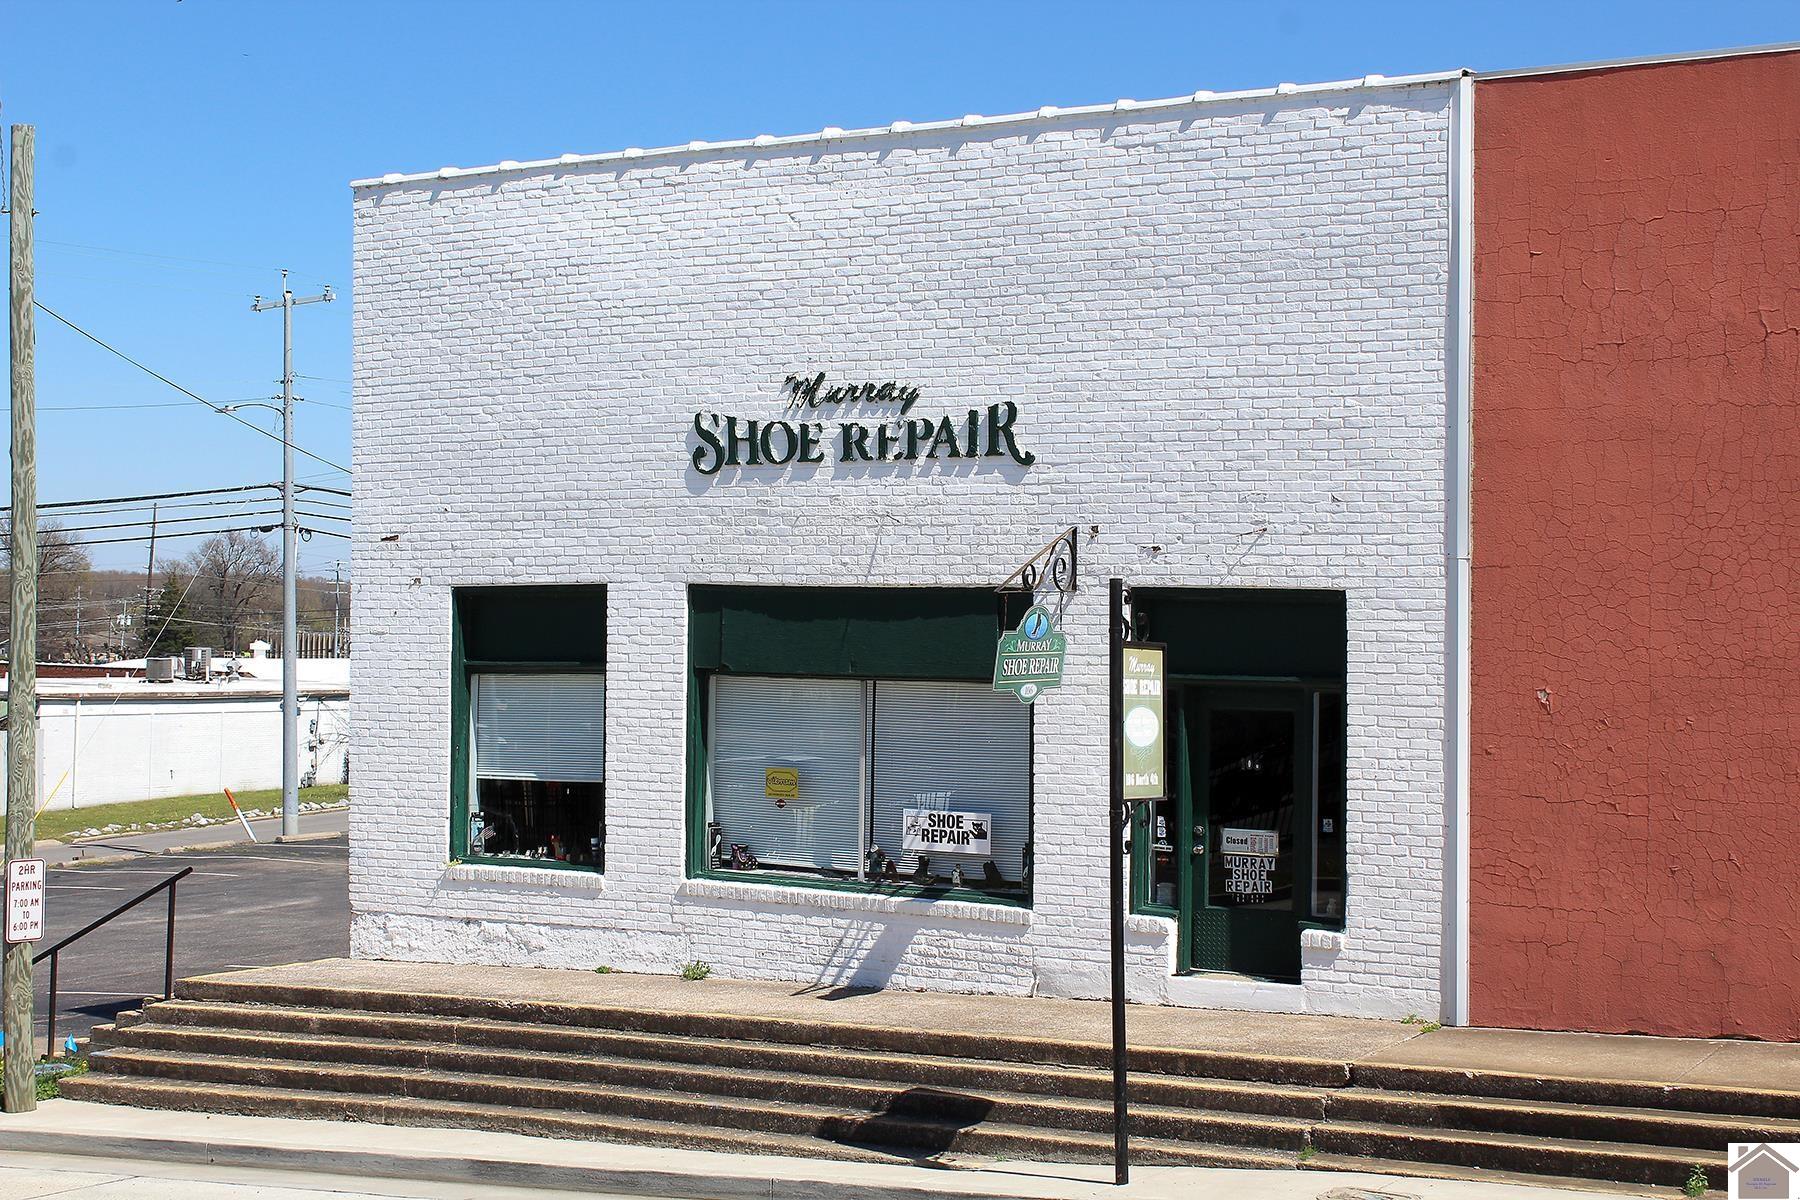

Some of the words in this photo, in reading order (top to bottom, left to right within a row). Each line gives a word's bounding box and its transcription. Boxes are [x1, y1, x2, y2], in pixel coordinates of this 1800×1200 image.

[785, 371, 921, 415] Murray
[693, 409, 825, 475] SHOE
[839, 400, 1035, 466] REPAIR
[1016, 639, 1052, 652] MURRAY
[1002, 659, 1028, 676] SHOE
[1028, 657, 1060, 675] REPAIR
[1128, 655, 1156, 677] Murray
[1139, 679, 1161, 695] REPAIR
[928, 813, 964, 829] SHOE
[921, 828, 970, 845] REPAIR
[1225, 836, 1248, 845] Closed
[1225, 856, 1274, 870] MURRAY
[18, 864, 36, 876] 2HR
[1233, 869, 1266, 881] SHOE
[11, 880, 42, 891] PARKING
[1226, 880, 1272, 893] REPAIR
[13, 898, 29, 908] 7:00
[29, 897, 40, 907] AM
[22, 910, 30, 919] TO
[12, 922, 28, 931] 6:00
[29, 920, 39, 929] PM
